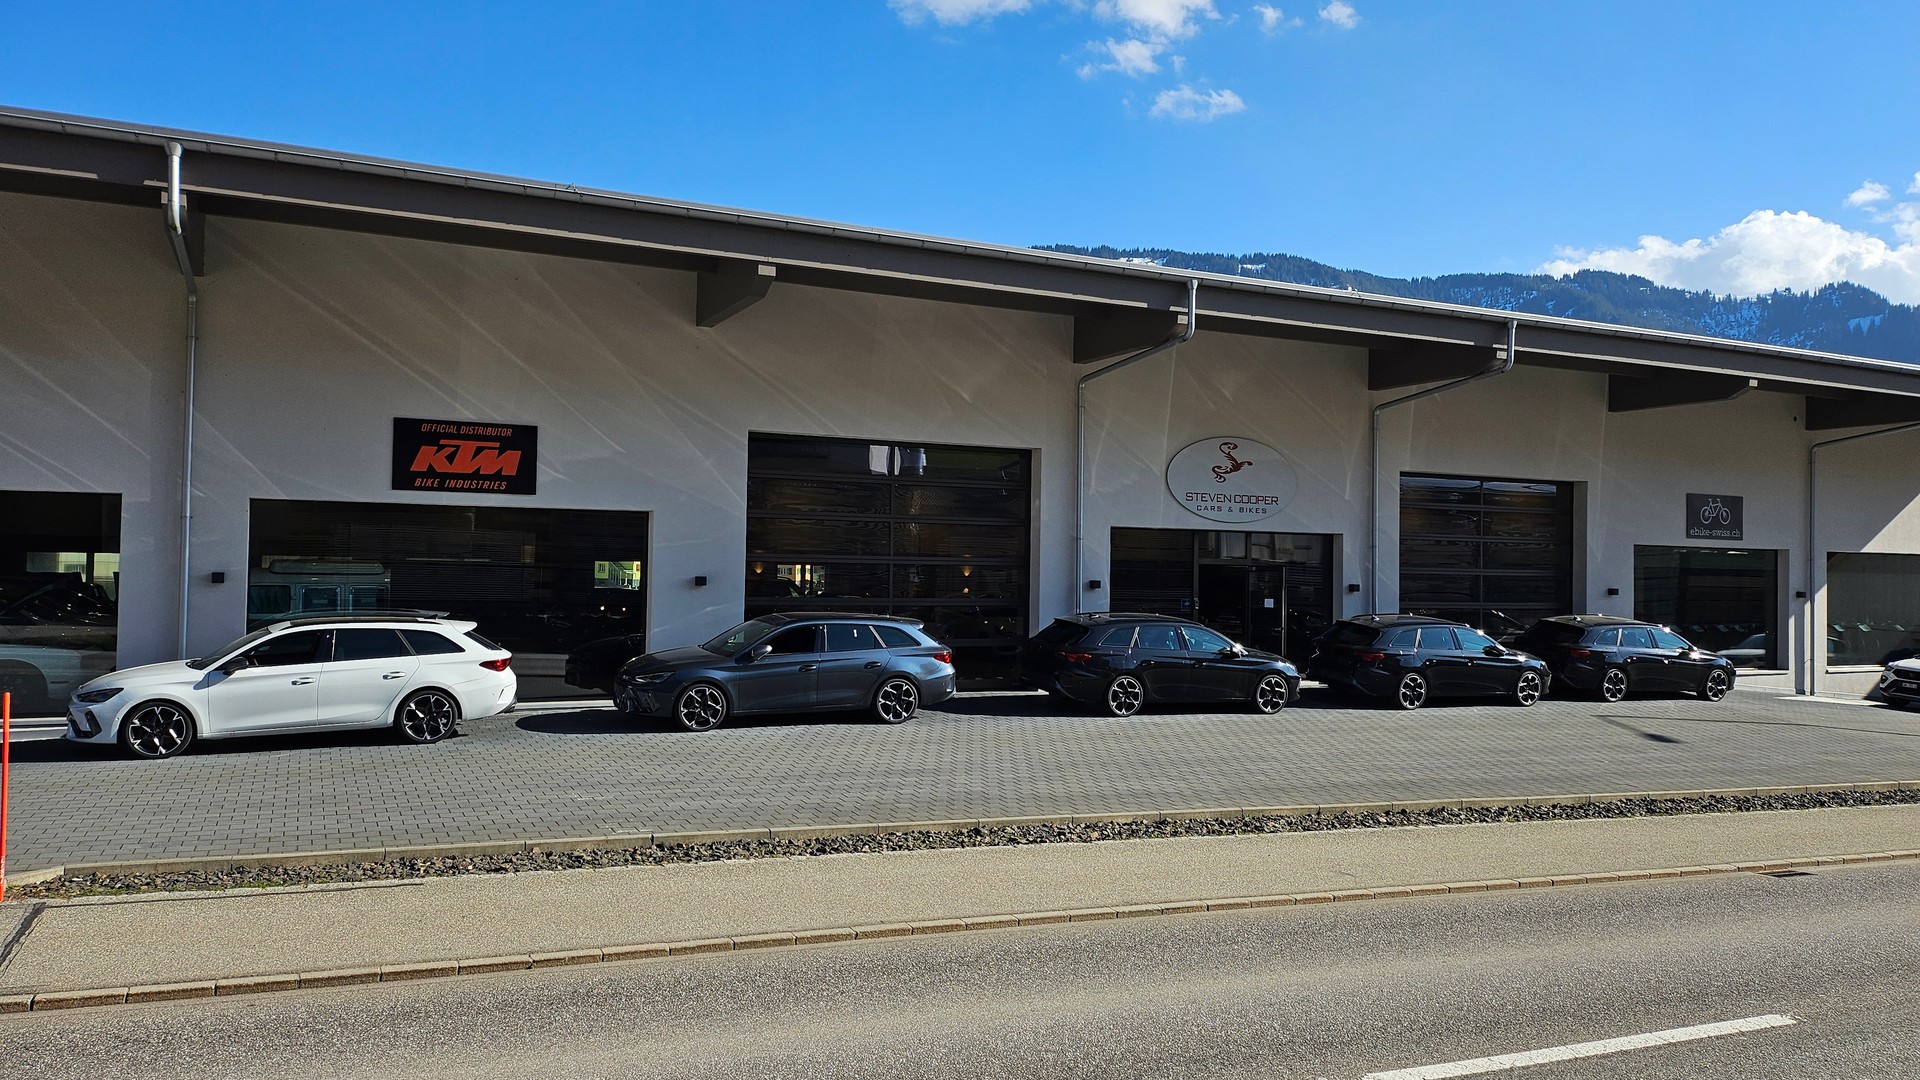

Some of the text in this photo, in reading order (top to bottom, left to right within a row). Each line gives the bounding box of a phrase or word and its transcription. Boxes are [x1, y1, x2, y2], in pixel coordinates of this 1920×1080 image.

[421, 423, 512, 437] OFFICIAL DISTRIBUTOR
[410, 439, 521, 476] KTM
[414, 478, 507, 490] BIKE INDUSTRIES
[1185, 492, 1279, 505] STEVEN COOPER
[1196, 504, 1222, 512] CARS
[1238, 506, 1267, 514] BIKES
[1690, 527, 1741, 537] ebike-swiss.ch
